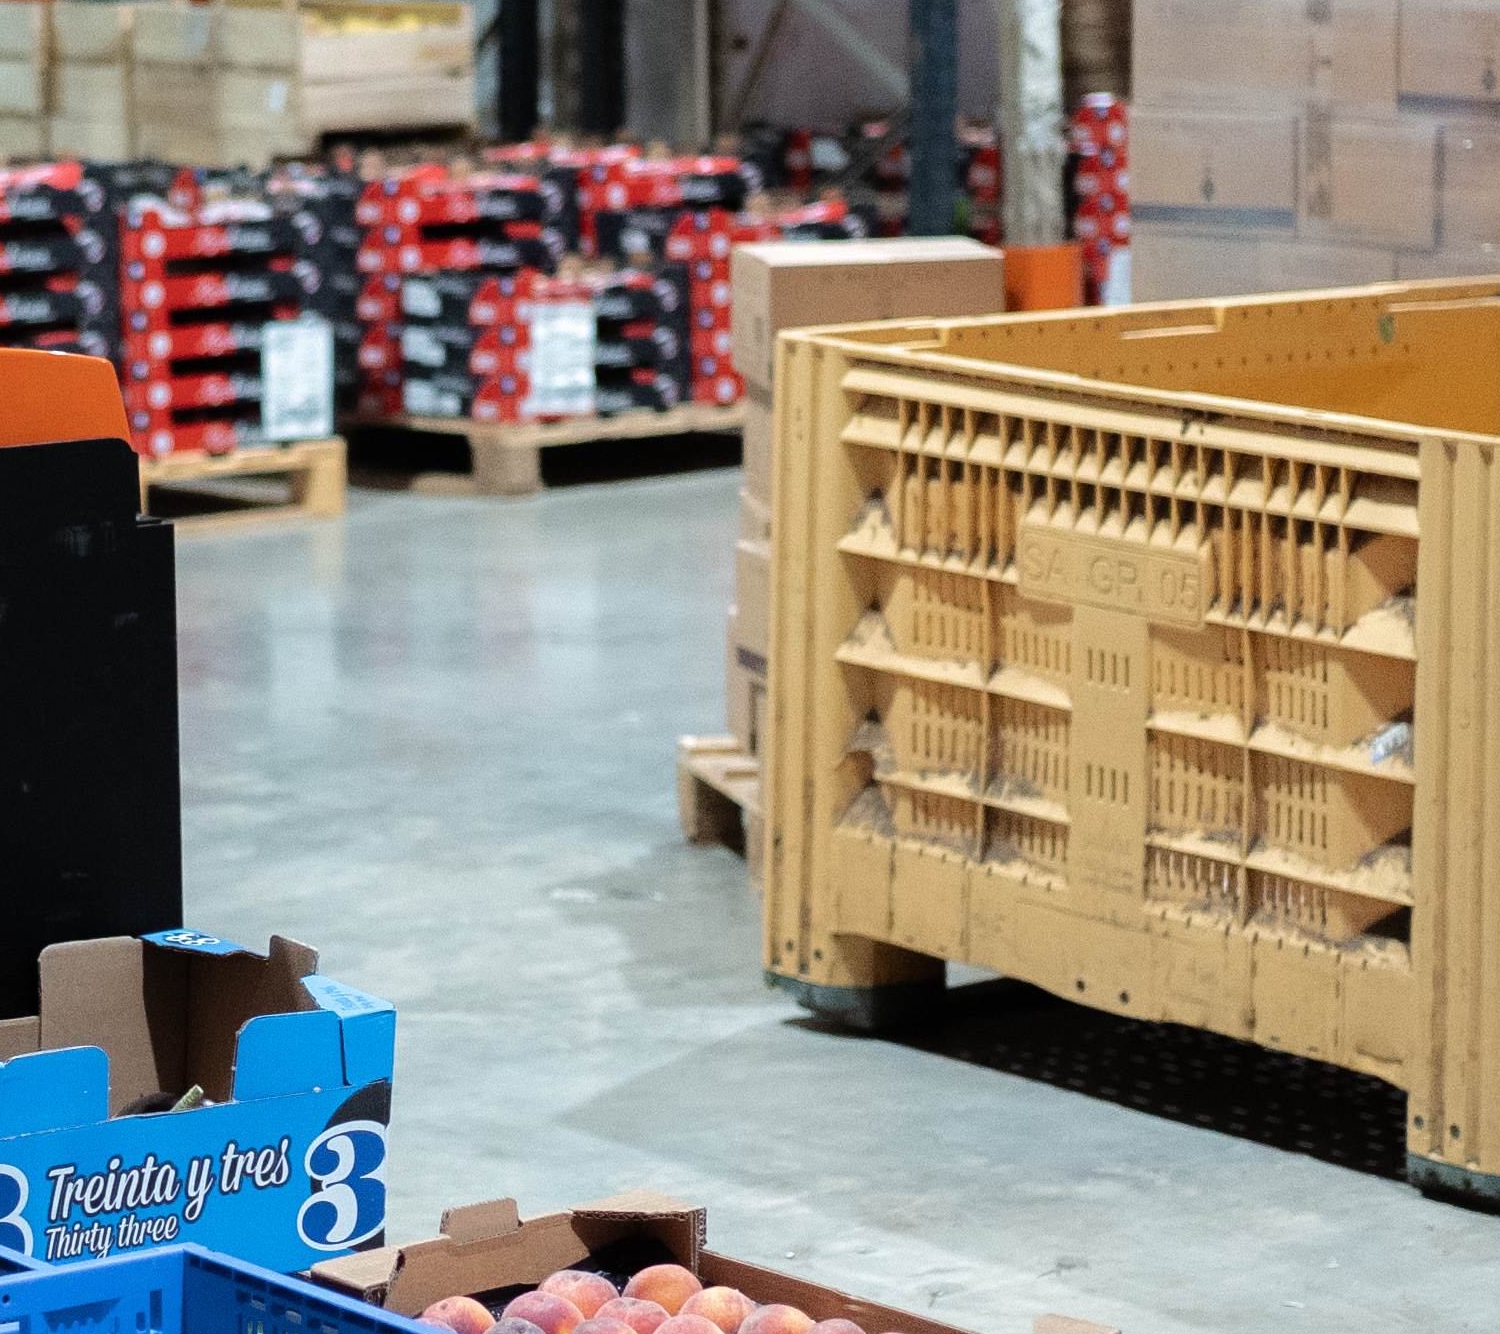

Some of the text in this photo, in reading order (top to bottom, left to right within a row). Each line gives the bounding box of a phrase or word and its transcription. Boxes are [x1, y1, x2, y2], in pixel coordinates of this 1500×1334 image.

[48, 1138, 291, 1221] Treinta y tres
[297, 1120, 387, 1252] 3
[45, 1214, 179, 1260] Thirty three
